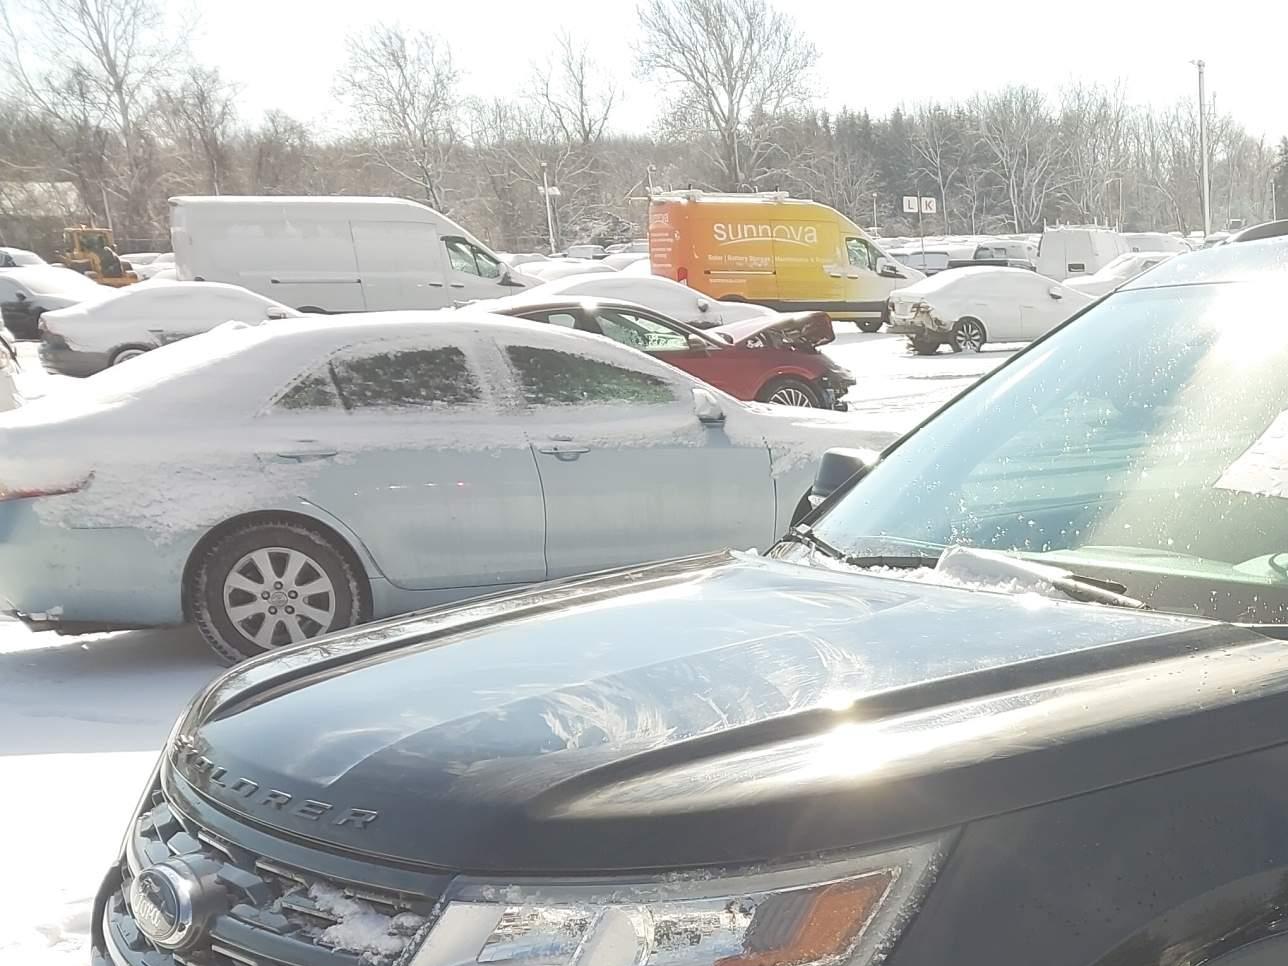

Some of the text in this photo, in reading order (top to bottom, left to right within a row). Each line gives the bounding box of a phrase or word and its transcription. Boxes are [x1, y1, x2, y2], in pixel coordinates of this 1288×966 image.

[907, 199, 915, 210] L
[925, 199, 933, 210] K
[712, 222, 818, 244] sunnova
